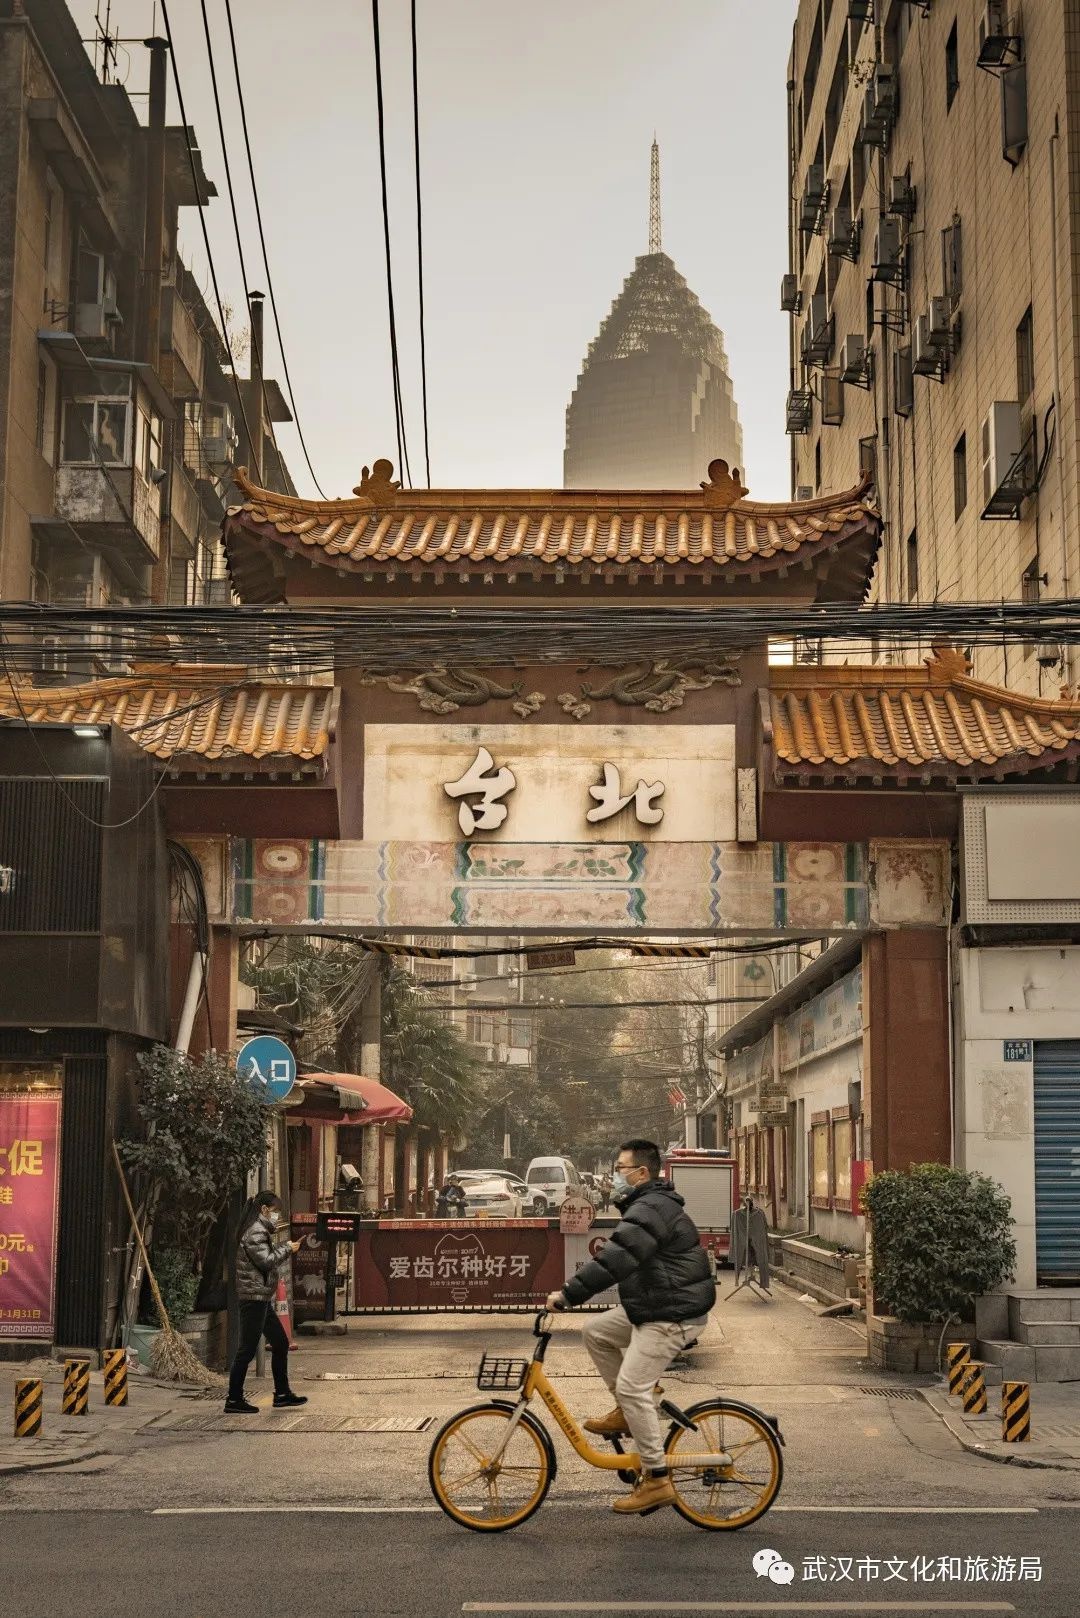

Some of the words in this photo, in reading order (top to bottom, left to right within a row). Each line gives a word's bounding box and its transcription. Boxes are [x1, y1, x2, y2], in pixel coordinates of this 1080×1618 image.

[443, 746, 665, 837] 台北
[245, 1056, 290, 1084] 入口
[0, 1139, 43, 1176] 促
[389, 1254, 531, 1279] 爱齿尔种好牙
